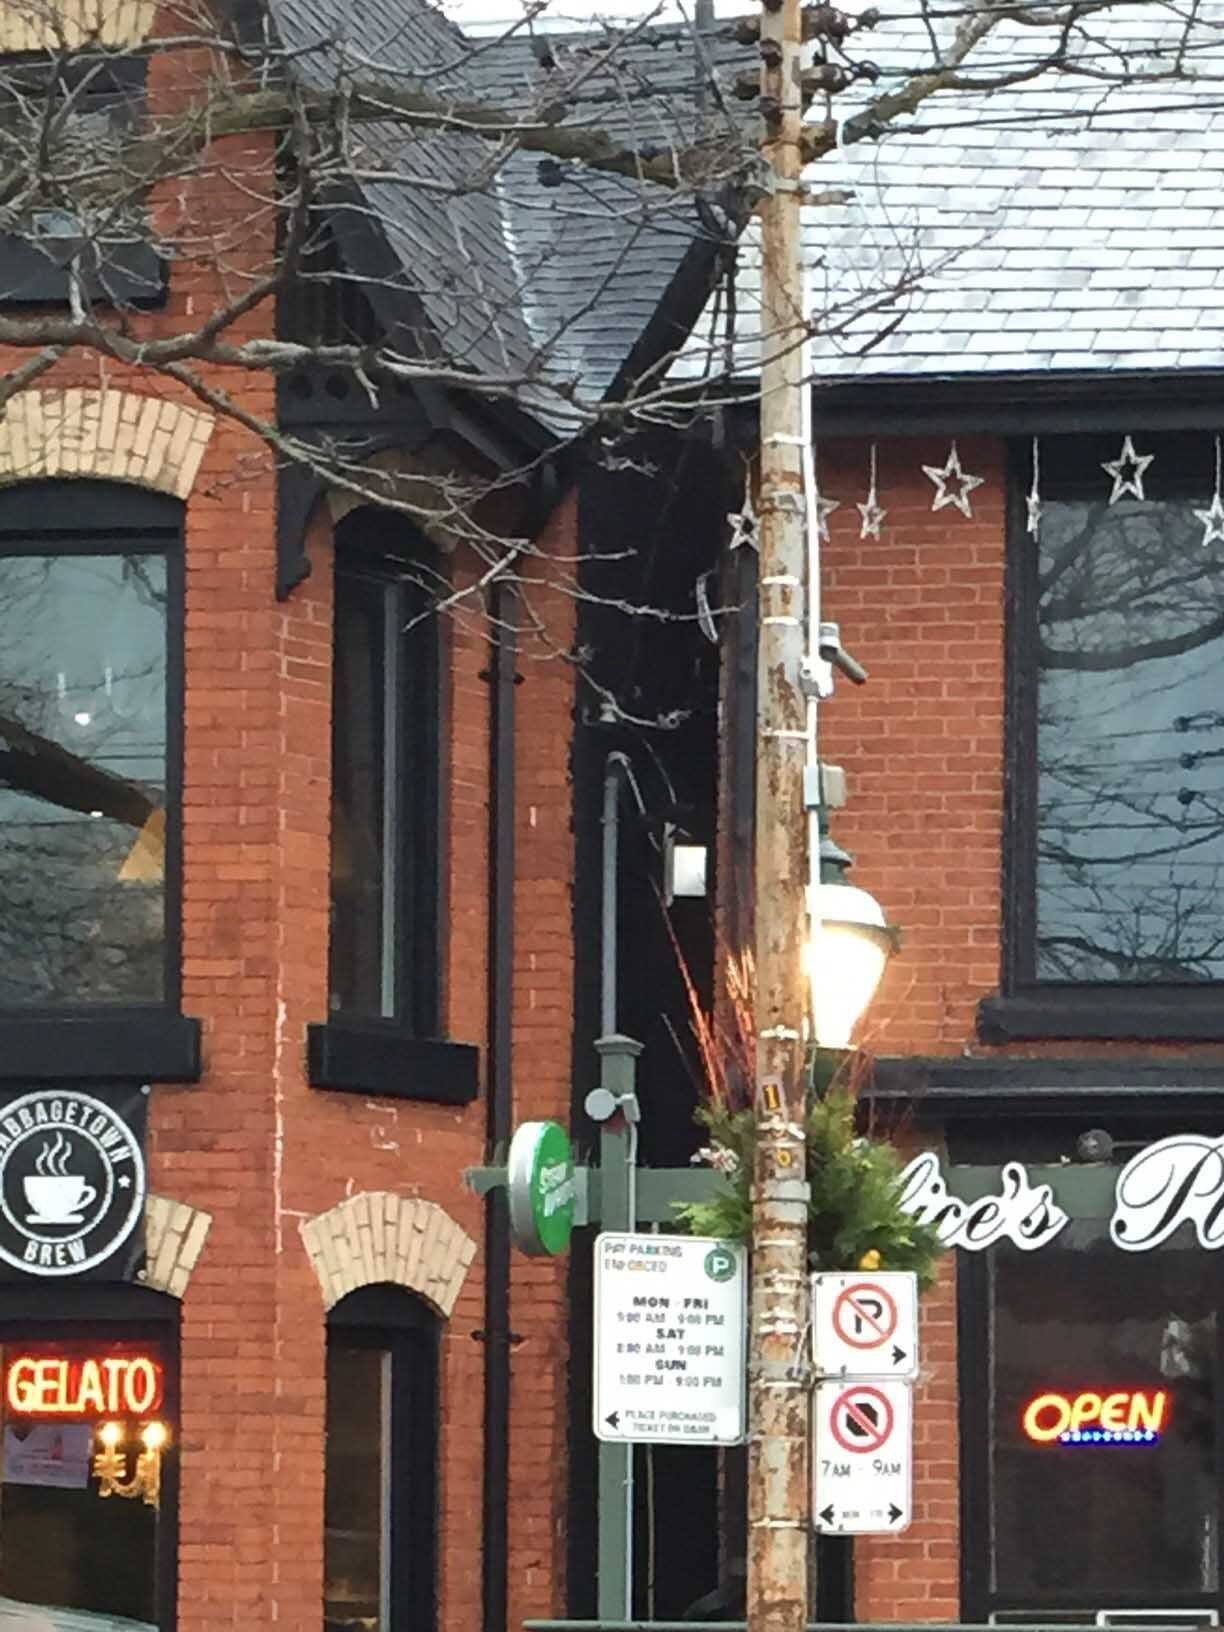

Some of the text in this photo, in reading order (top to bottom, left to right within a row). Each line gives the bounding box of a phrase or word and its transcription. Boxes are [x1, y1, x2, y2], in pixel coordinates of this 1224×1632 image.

[0, 1100, 132, 1163] ABBAGETOWN
[892, 1154, 1067, 1244] lice's
[23, 1238, 87, 1265] BREW
[633, 1296, 709, 1310] MON FRI
[656, 1328, 685, 1340] SAT
[655, 1359, 687, 1371] SUN
[8, 1357, 157, 1414] GELATO
[1023, 1390, 1167, 1442] OPEN
[821, 1459, 851, 1477] 7AM
[872, 1459, 901, 1476] 9AM
